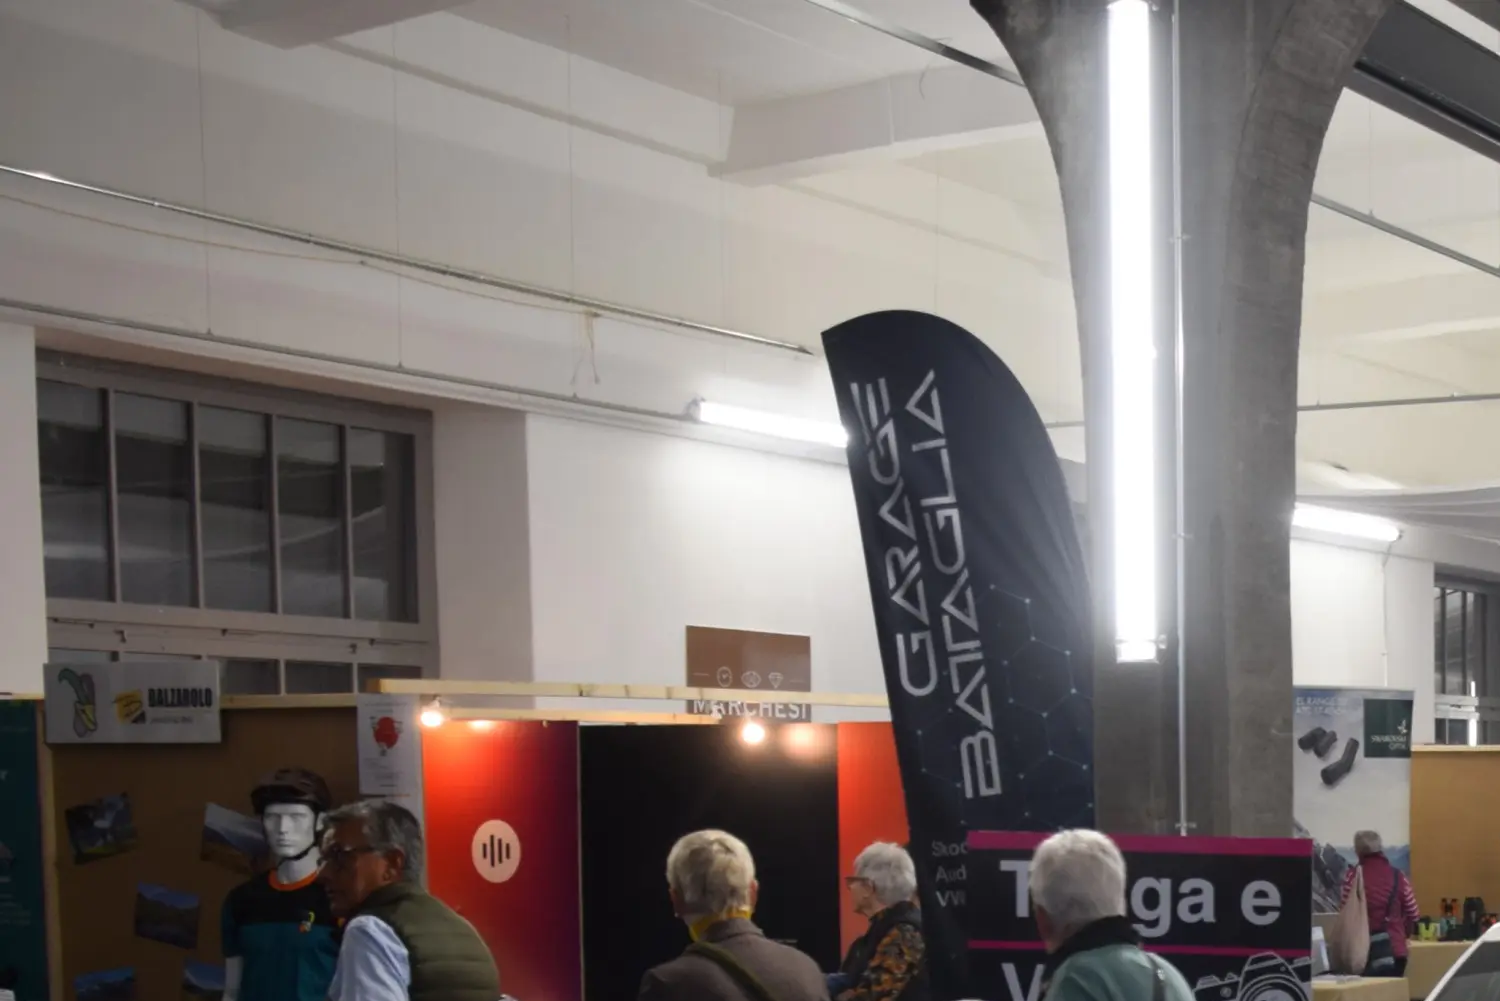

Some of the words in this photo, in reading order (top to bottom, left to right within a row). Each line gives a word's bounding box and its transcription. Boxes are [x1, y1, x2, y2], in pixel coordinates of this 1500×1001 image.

[850, 376, 940, 697] GARAGE
[905, 369, 1002, 799] BATTAGLIA
[693, 699, 807, 719] MARCHESI
[935, 864, 967, 882] Aud
[1000, 859, 1215, 937] Tga
[1241, 878, 1282, 926] e
